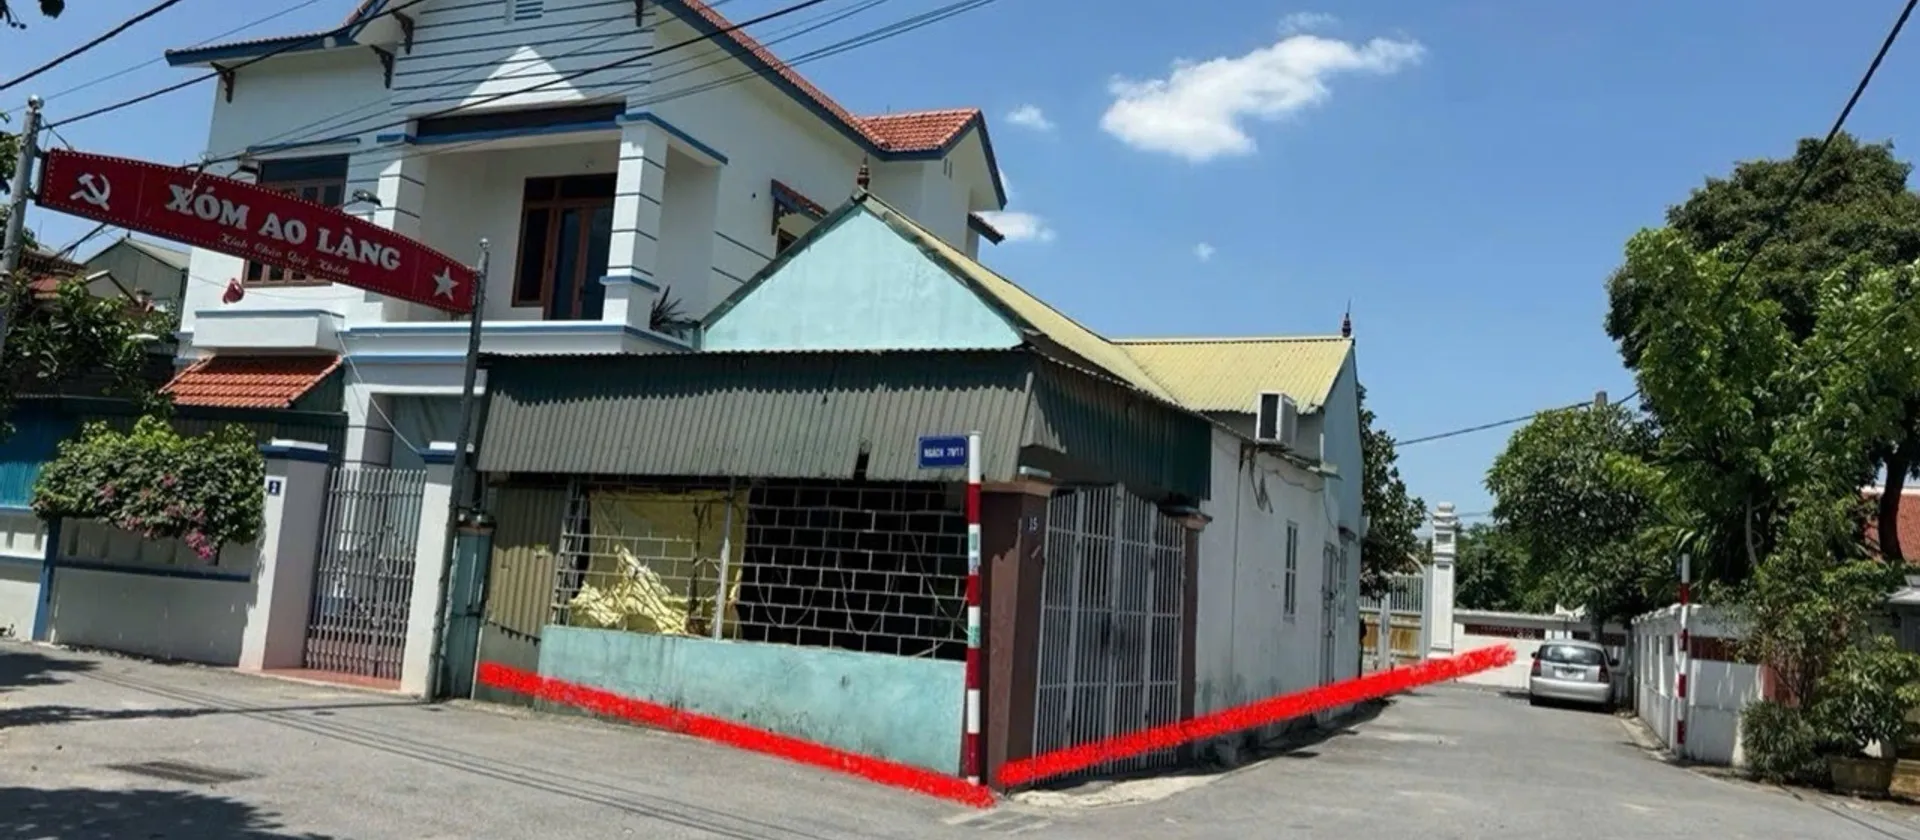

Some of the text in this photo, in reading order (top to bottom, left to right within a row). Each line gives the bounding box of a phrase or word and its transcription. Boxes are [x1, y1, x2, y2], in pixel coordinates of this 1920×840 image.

[165, 184, 401, 270] XÓM AO LÀNG
